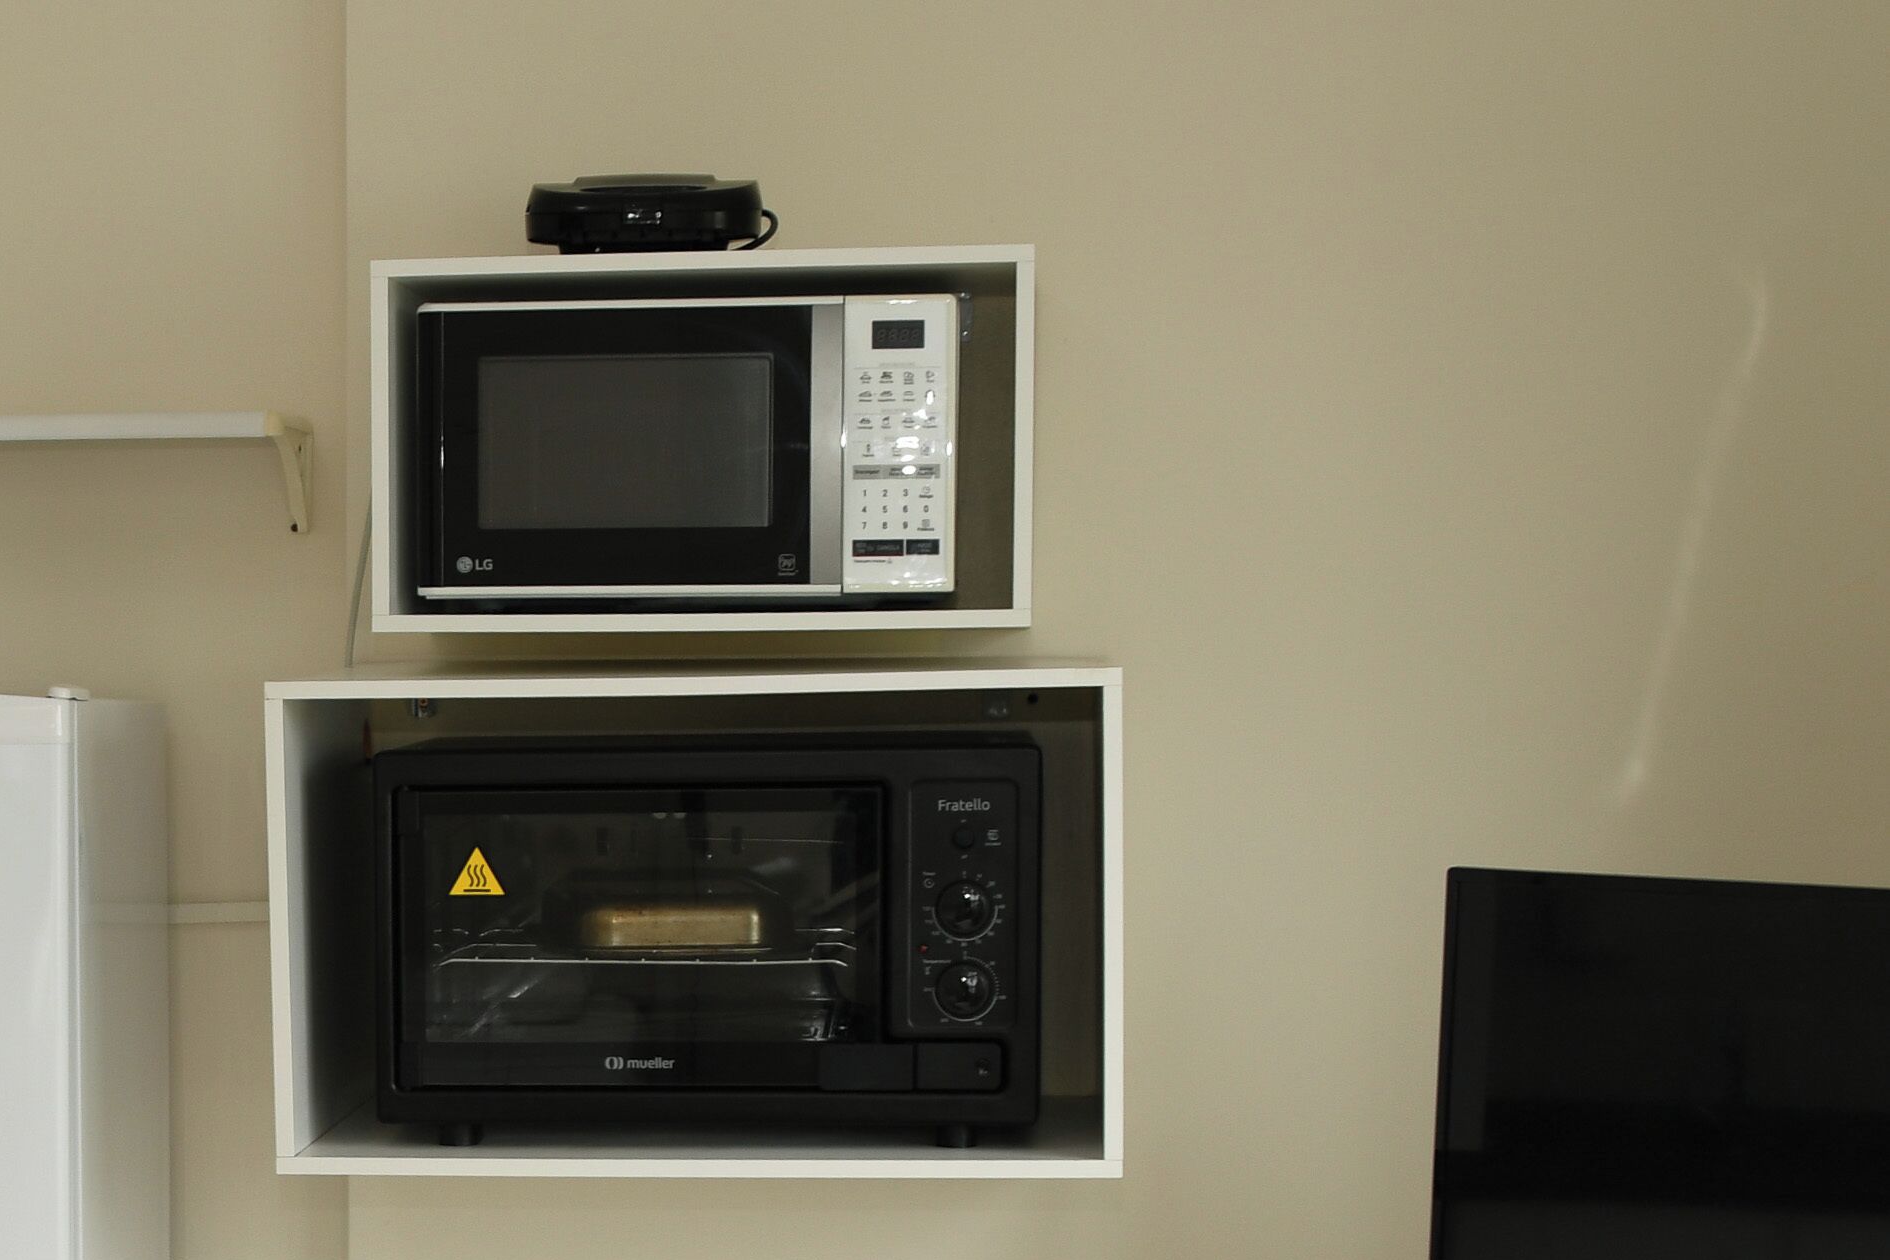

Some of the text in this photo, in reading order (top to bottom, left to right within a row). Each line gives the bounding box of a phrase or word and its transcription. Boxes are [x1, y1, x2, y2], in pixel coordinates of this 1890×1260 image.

[882, 489, 888, 497] 2
[903, 488, 909, 497] 3
[861, 505, 867, 513] 4
[882, 505, 888, 513] 5
[903, 505, 909, 513] 6
[862, 521, 867, 530] 7
[882, 521, 888, 530] 8
[903, 521, 909, 529] 9
[475, 558, 494, 571] LG
[937, 797, 991, 812] Fratello
[626, 1056, 676, 1070] mueller
